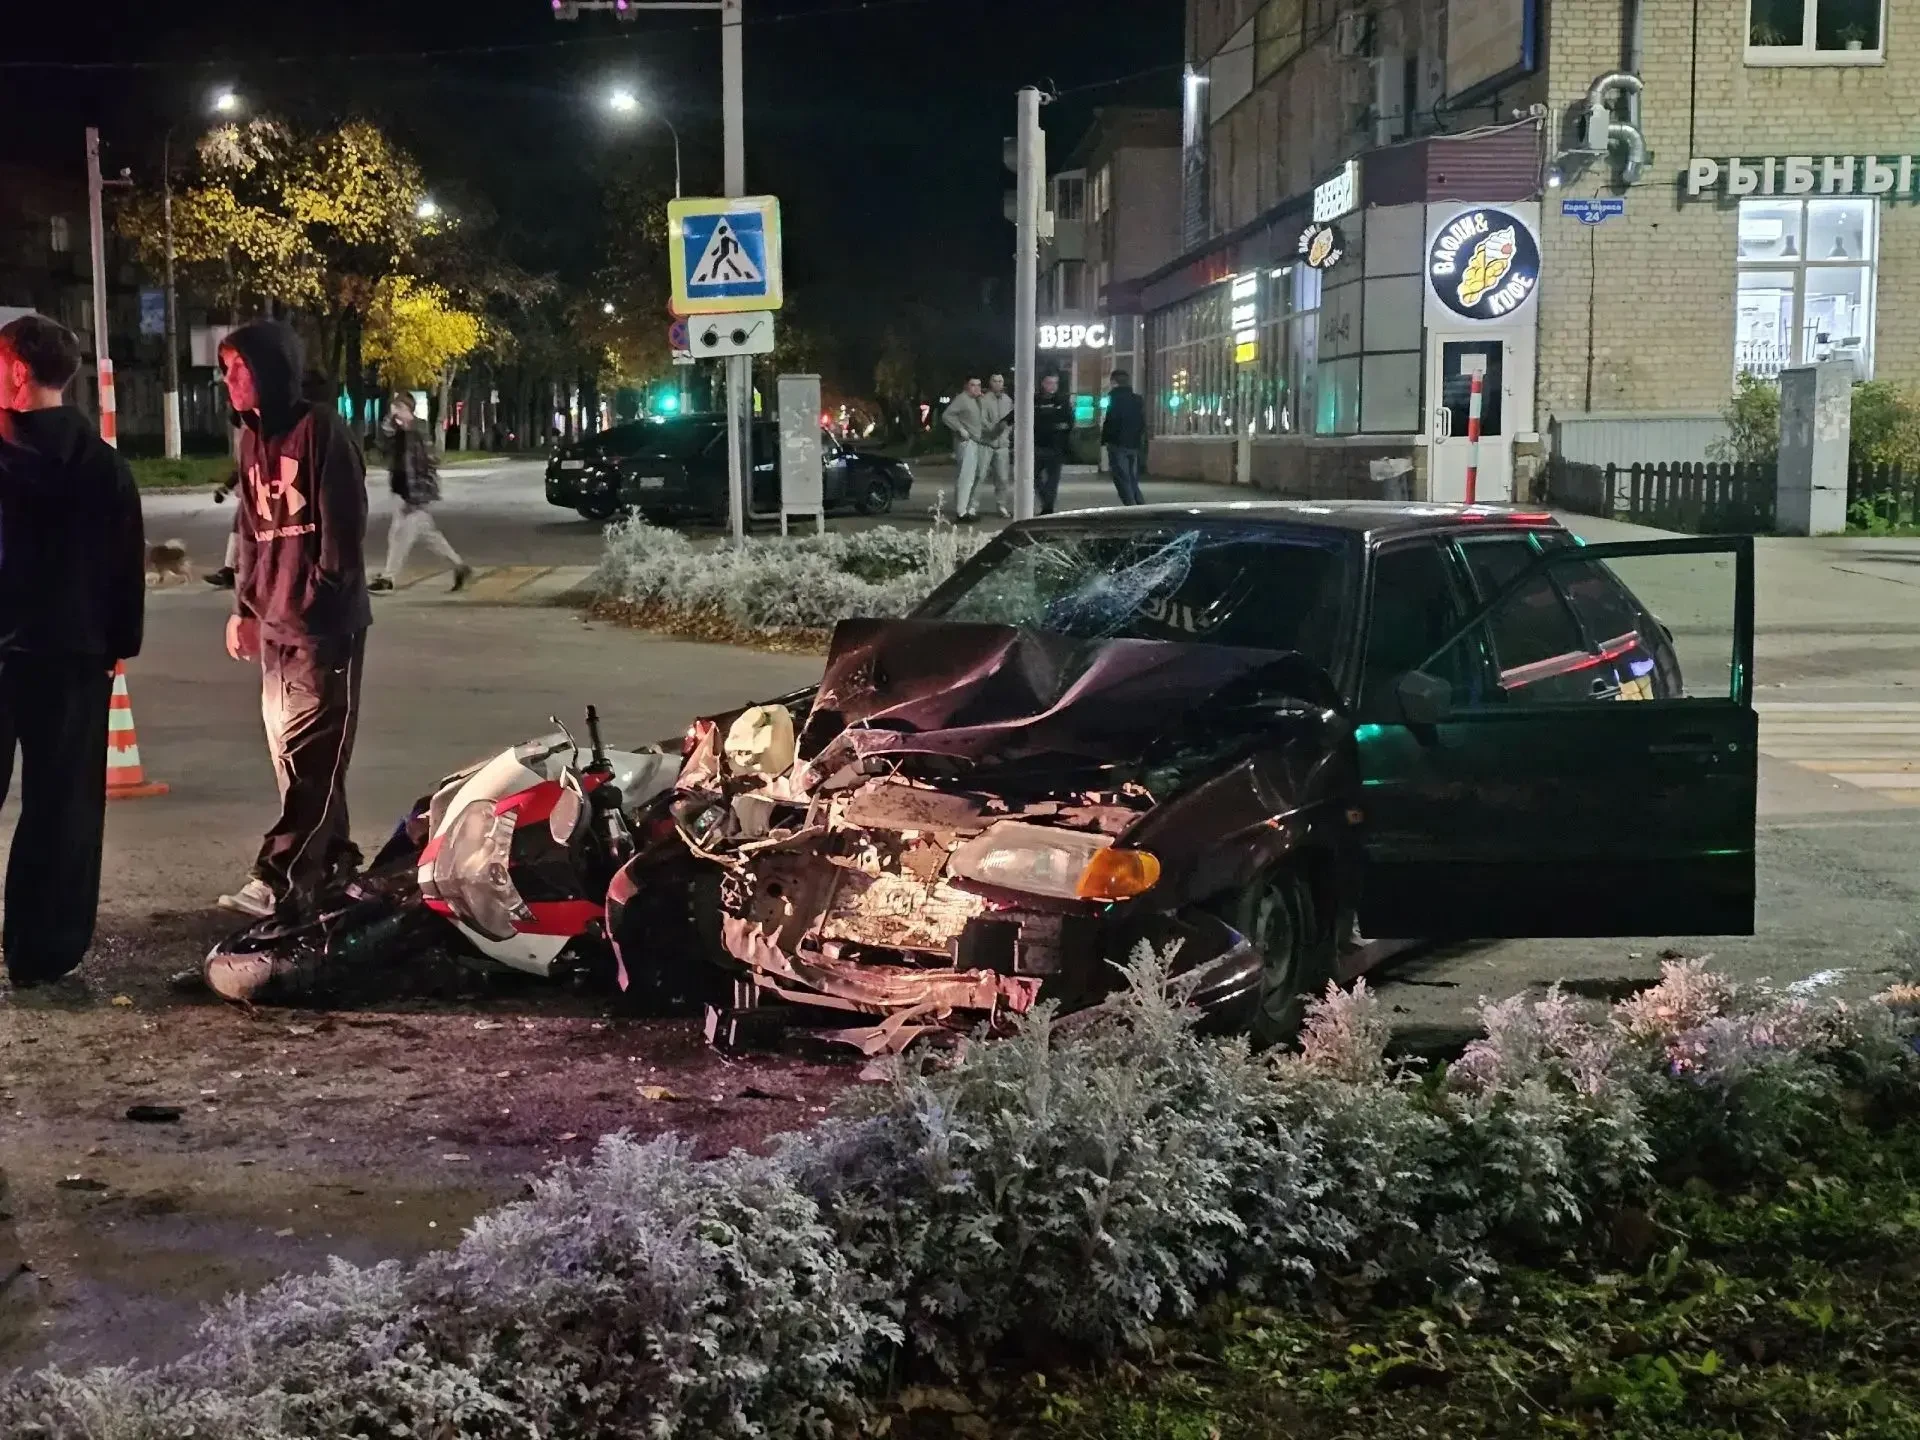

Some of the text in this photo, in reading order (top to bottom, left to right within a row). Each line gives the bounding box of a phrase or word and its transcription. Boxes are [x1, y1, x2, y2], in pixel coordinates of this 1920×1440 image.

[1687, 154, 1919, 196] РЫБНЫ
[1564, 204, 1622, 212] Карла Маркса
[1585, 211, 1600, 221] 24
[1488, 272, 1534, 315] КОФЕ
[1038, 323, 1114, 348] ВЕРС
